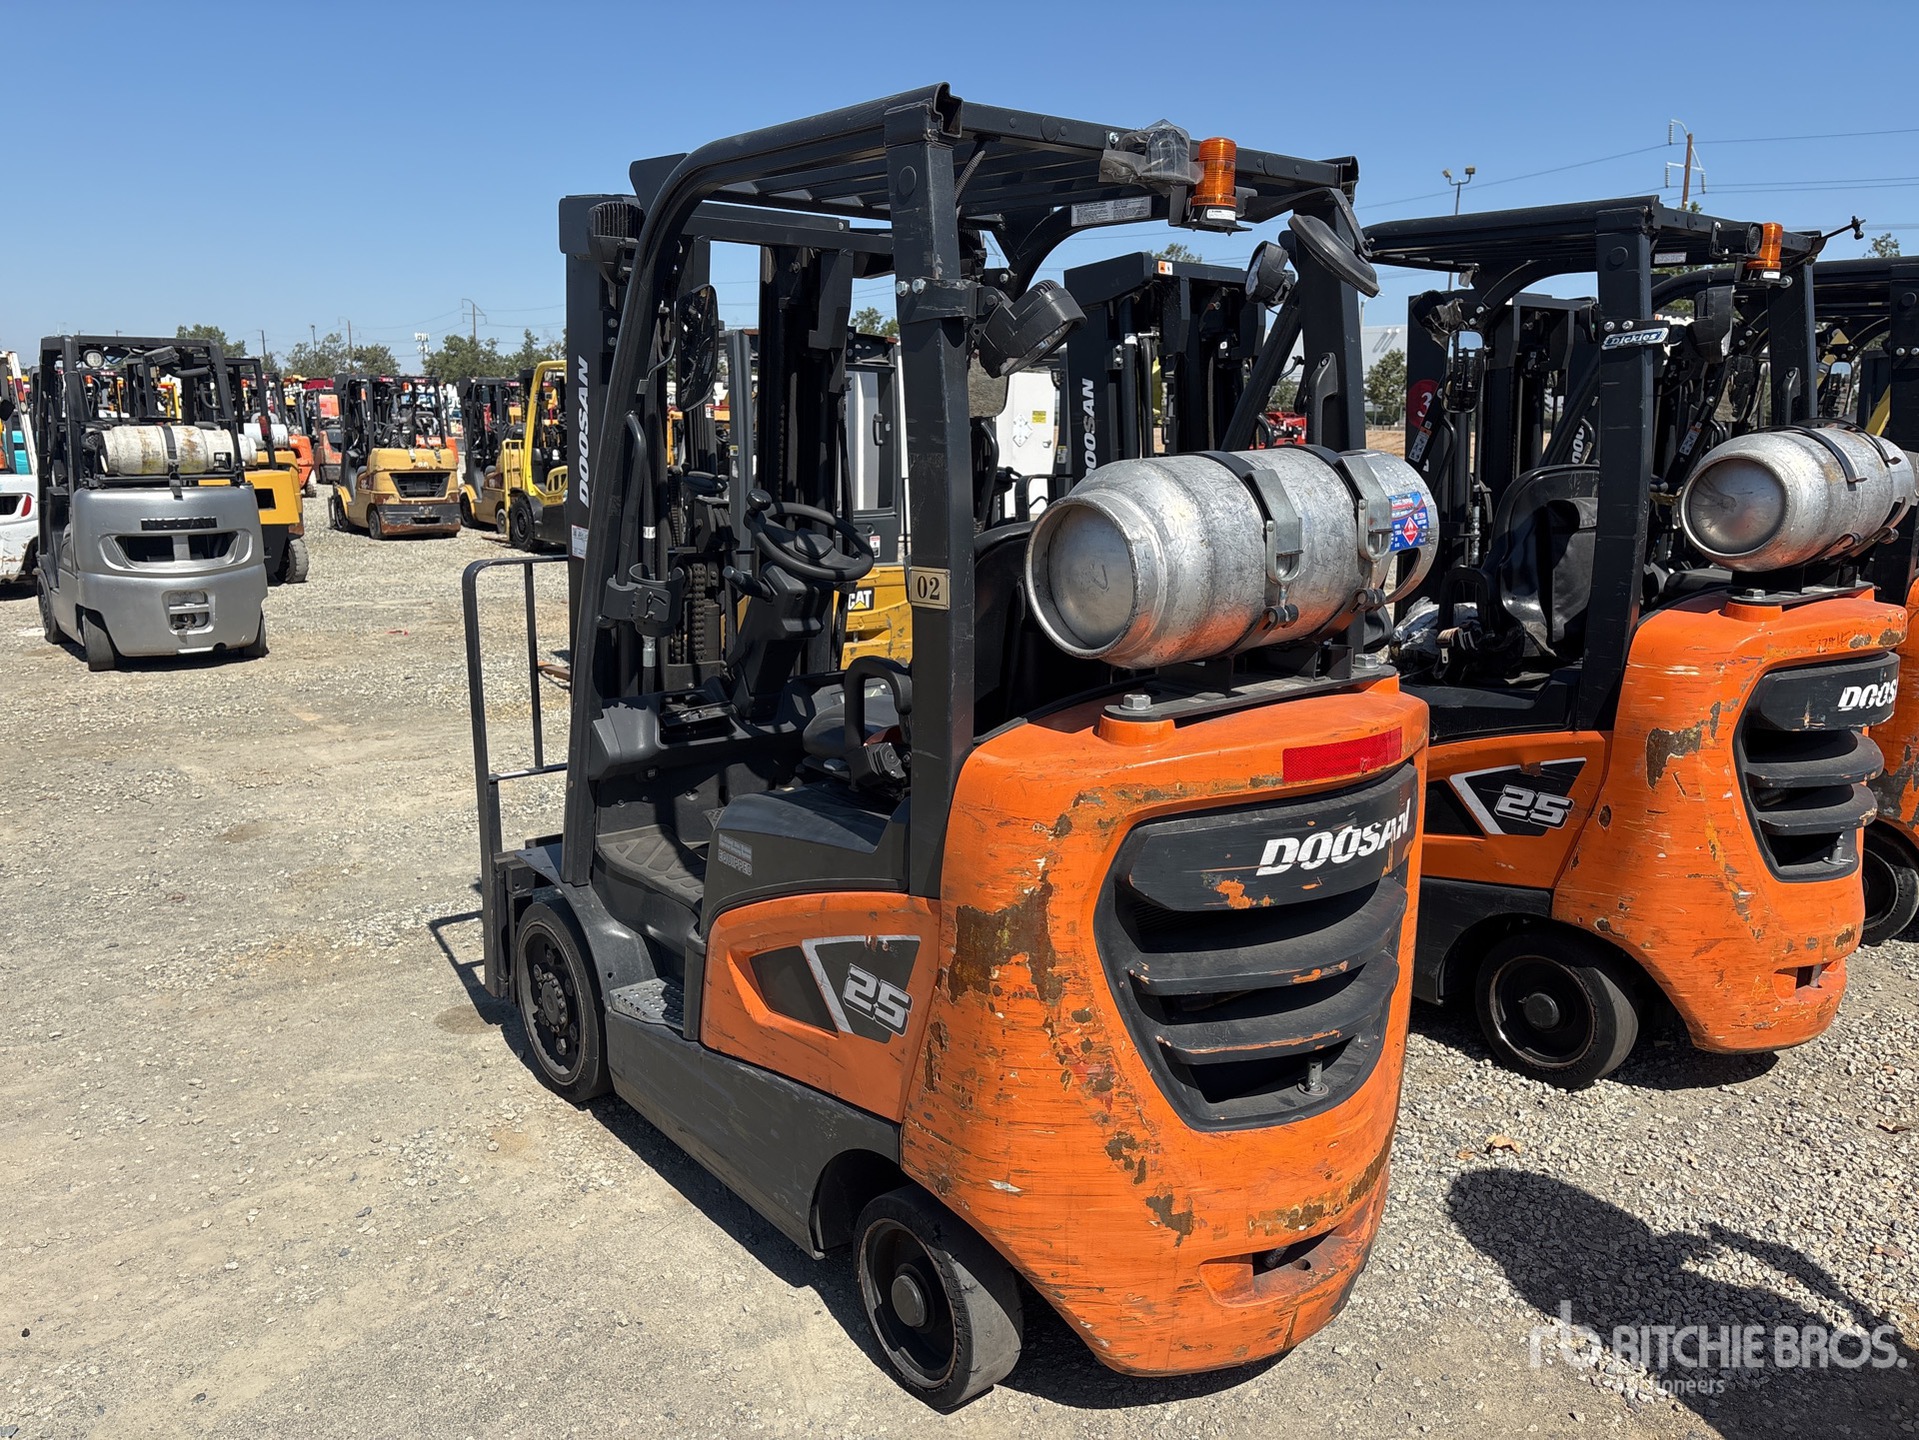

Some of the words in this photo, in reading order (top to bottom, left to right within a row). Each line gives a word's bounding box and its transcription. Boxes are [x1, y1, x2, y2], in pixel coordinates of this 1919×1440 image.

[1610, 332, 1657, 347] Dickies
[577, 353, 590, 509] DOOSAN
[1081, 377, 1096, 477] OOSAN
[847, 589, 872, 611] CAT
[916, 575, 941, 601] 02
[1255, 797, 1411, 877] DOOSAN
[1493, 783, 1575, 840] 25
[717, 847, 753, 877] EQUIPPED
[842, 962, 914, 1038] 25
